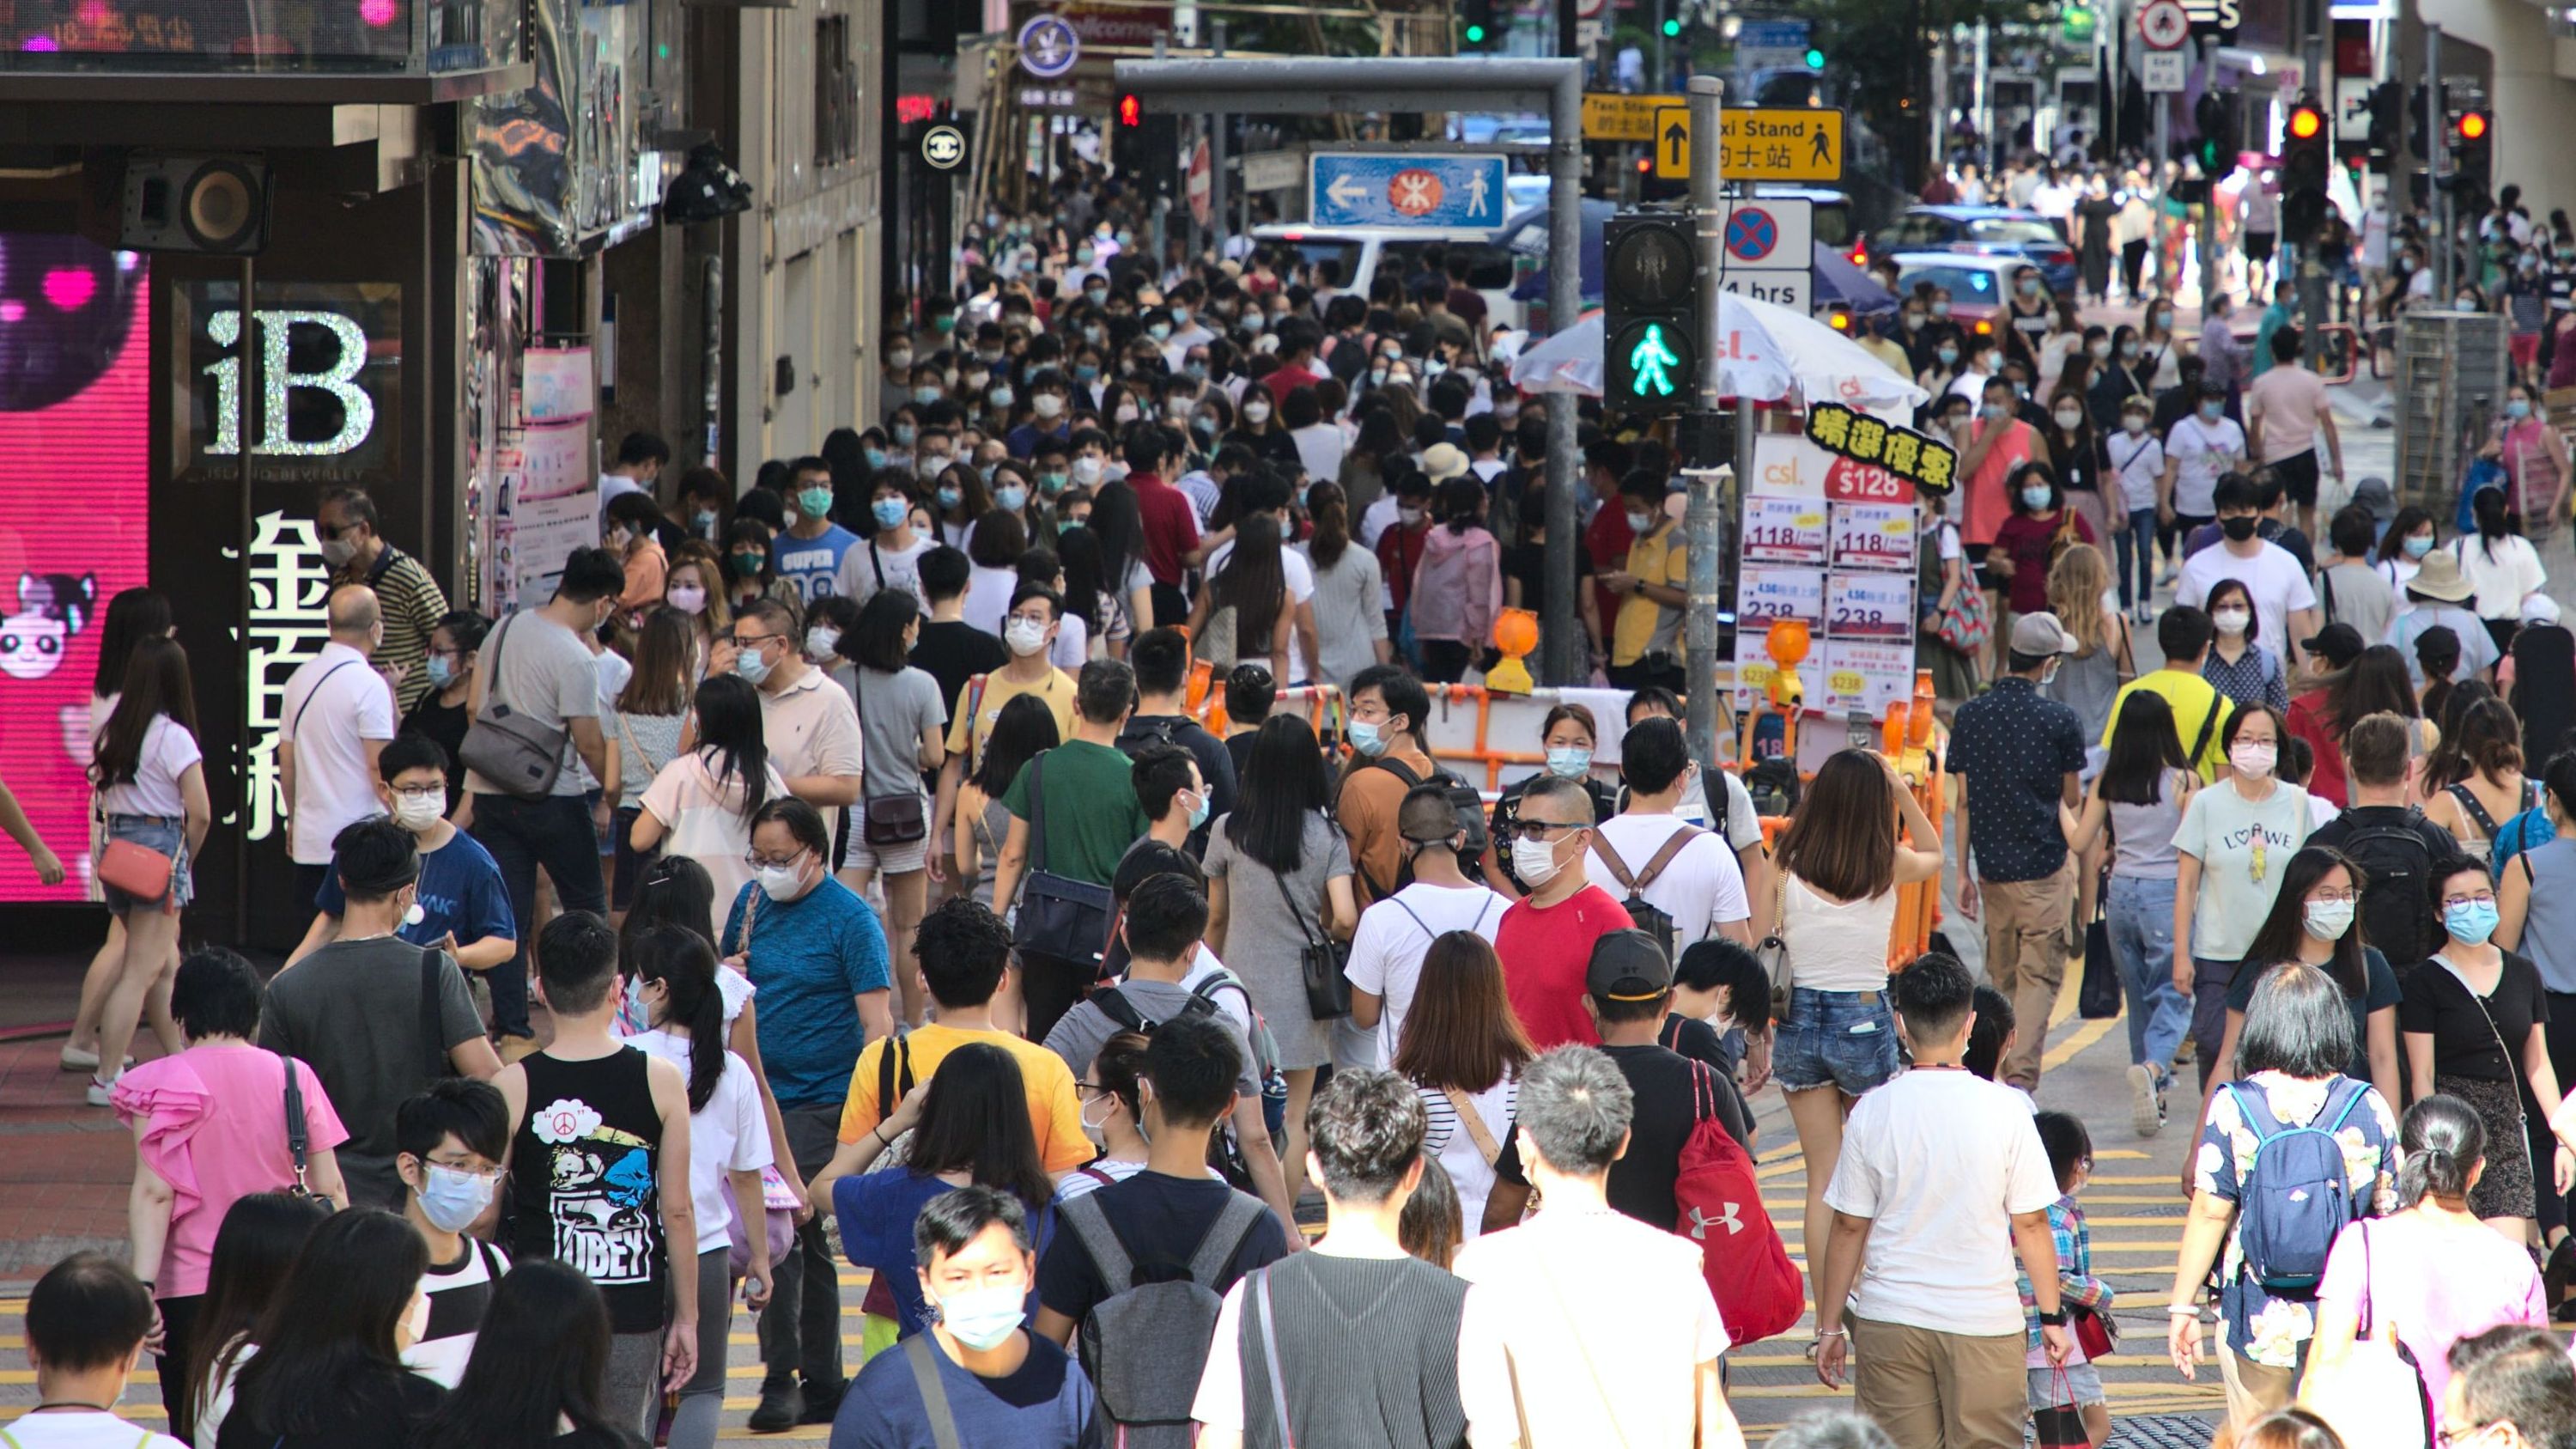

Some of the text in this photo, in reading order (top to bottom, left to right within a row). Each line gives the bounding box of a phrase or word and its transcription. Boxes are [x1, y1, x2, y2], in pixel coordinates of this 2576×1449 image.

[1593, 100, 1656, 113] Taxi Stan
[1720, 119, 1805, 138] xi Stand
[1751, 281, 1795, 304] hrs
[202, 309, 375, 456] iB
[1812, 406, 1953, 490] 精選優惠
[1765, 455, 1804, 486] csl.
[1838, 468, 1899, 497] $128
[781, 548, 834, 572] SUPER
[1837, 607, 1882, 630] 238
[1832, 675, 1861, 691] $238
[562, 1228, 644, 1279] OBEY
